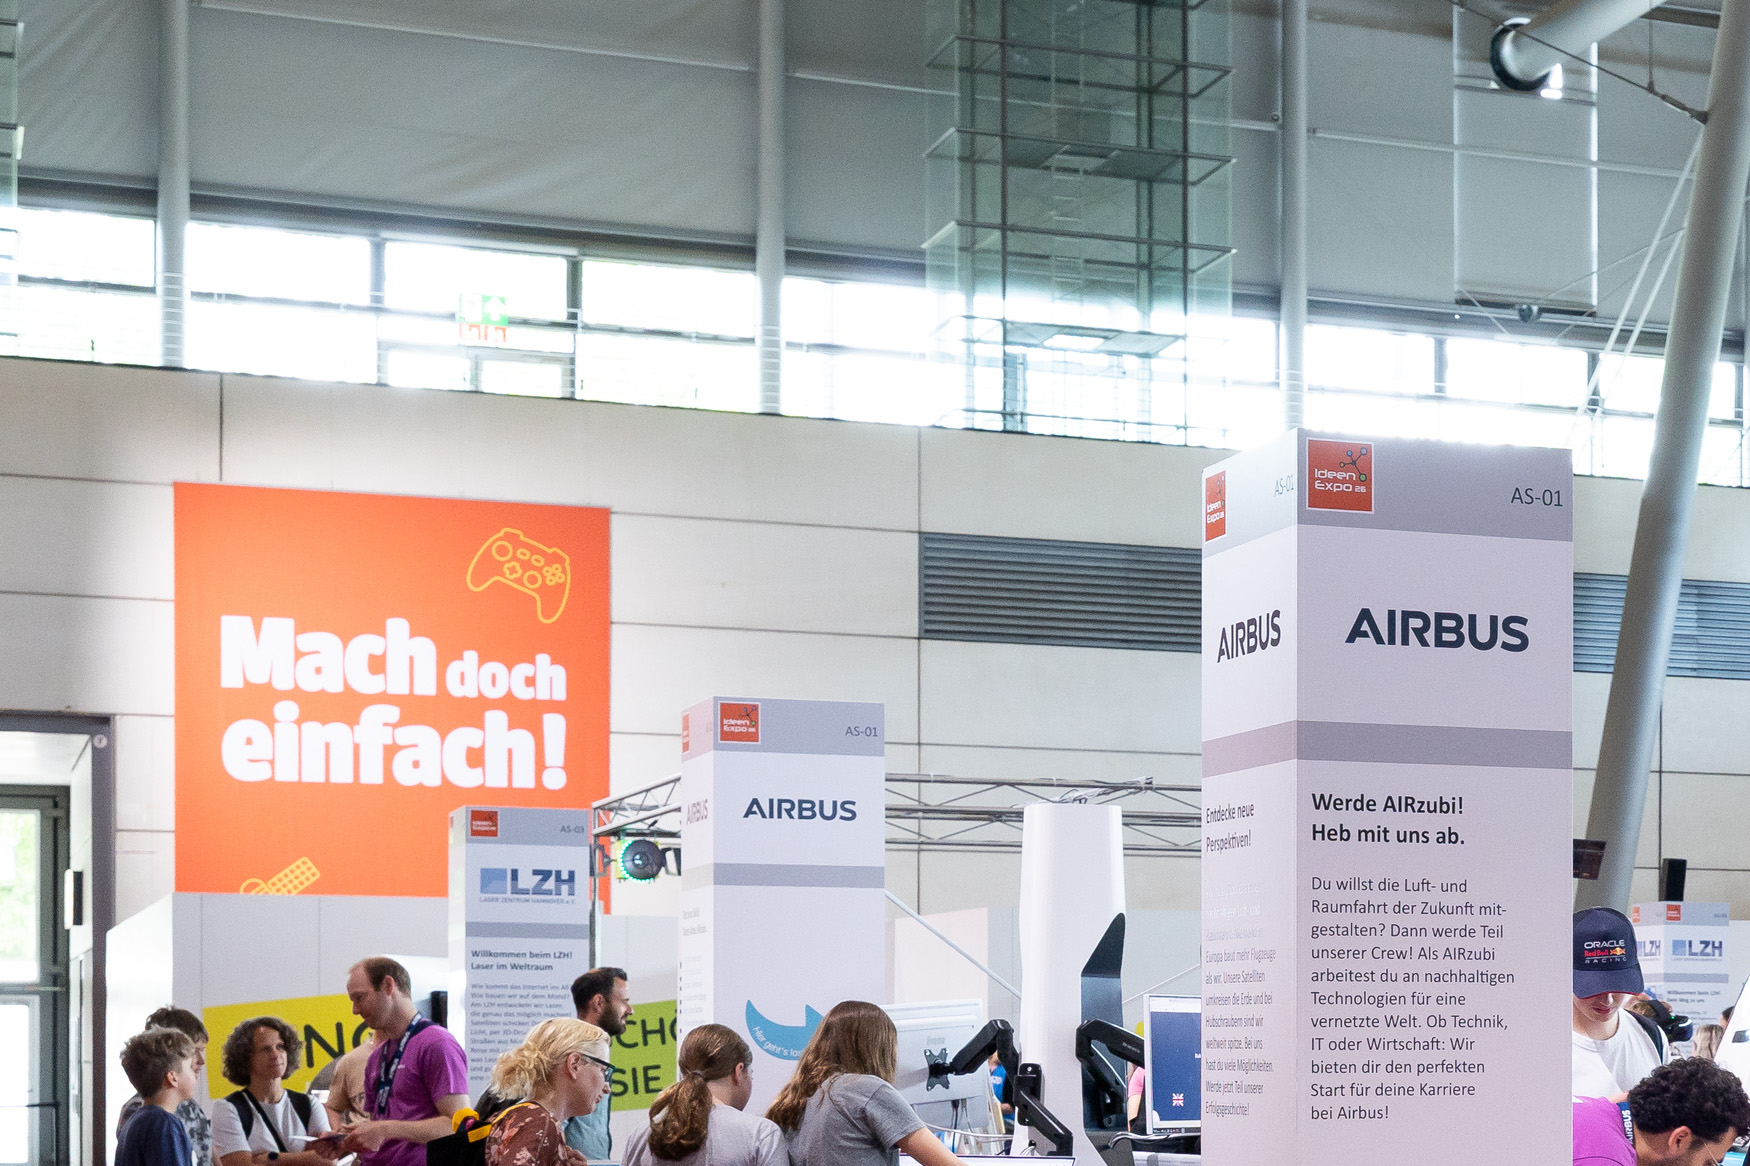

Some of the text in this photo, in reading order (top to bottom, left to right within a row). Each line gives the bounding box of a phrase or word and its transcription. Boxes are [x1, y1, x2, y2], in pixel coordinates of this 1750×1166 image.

[1315, 468, 1356, 480] Ideen
[1315, 480, 1353, 493] Expo
[1511, 487, 1563, 507] AS-01
[1217, 610, 1281, 663] AIRBUS
[1345, 607, 1529, 652] AIRBUS
[220, 615, 566, 701] Mach doch
[845, 725, 878, 738] AS-01
[221, 701, 568, 790] einfach!
[743, 798, 857, 822] AIRBUS
[1312, 793, 1462, 814] Werde AIRzubi!
[1206, 804, 1254, 824] Entdecke neue
[1206, 829, 1251, 854] Perspektiven!
[1313, 824, 1464, 844] Heb mit uns ab.
[511, 868, 575, 896] LZH
[1312, 877, 1467, 893] Du willst die Luft- und
[1312, 900, 1506, 916] Raumfahrt der Zukunft mit-
[1311, 923, 1503, 939] gestalten? Dann werde Teil
[1584, 940, 1625, 948] ORACLE
[1688, 940, 1722, 956] LZH
[471, 950, 572, 959] Willkommen beim LZH!
[1312, 946, 1495, 961] unserer Crew! Als AIRzubi
[1311, 968, 1514, 986] arbeitest du an nachhaltigen
[1311, 991, 1465, 1008] Technologien für eine
[1311, 1014, 1507, 1030] vernetzte Welt. Ob Technik,
[1312, 1037, 1475, 1051] IT oder Wirtschaft: Wir
[1312, 1059, 1484, 1076] bieten dir den perfekten
[1311, 1082, 1475, 1097] Start für deine Karriere
[1311, 1106, 1388, 1120] bei Airbus!
